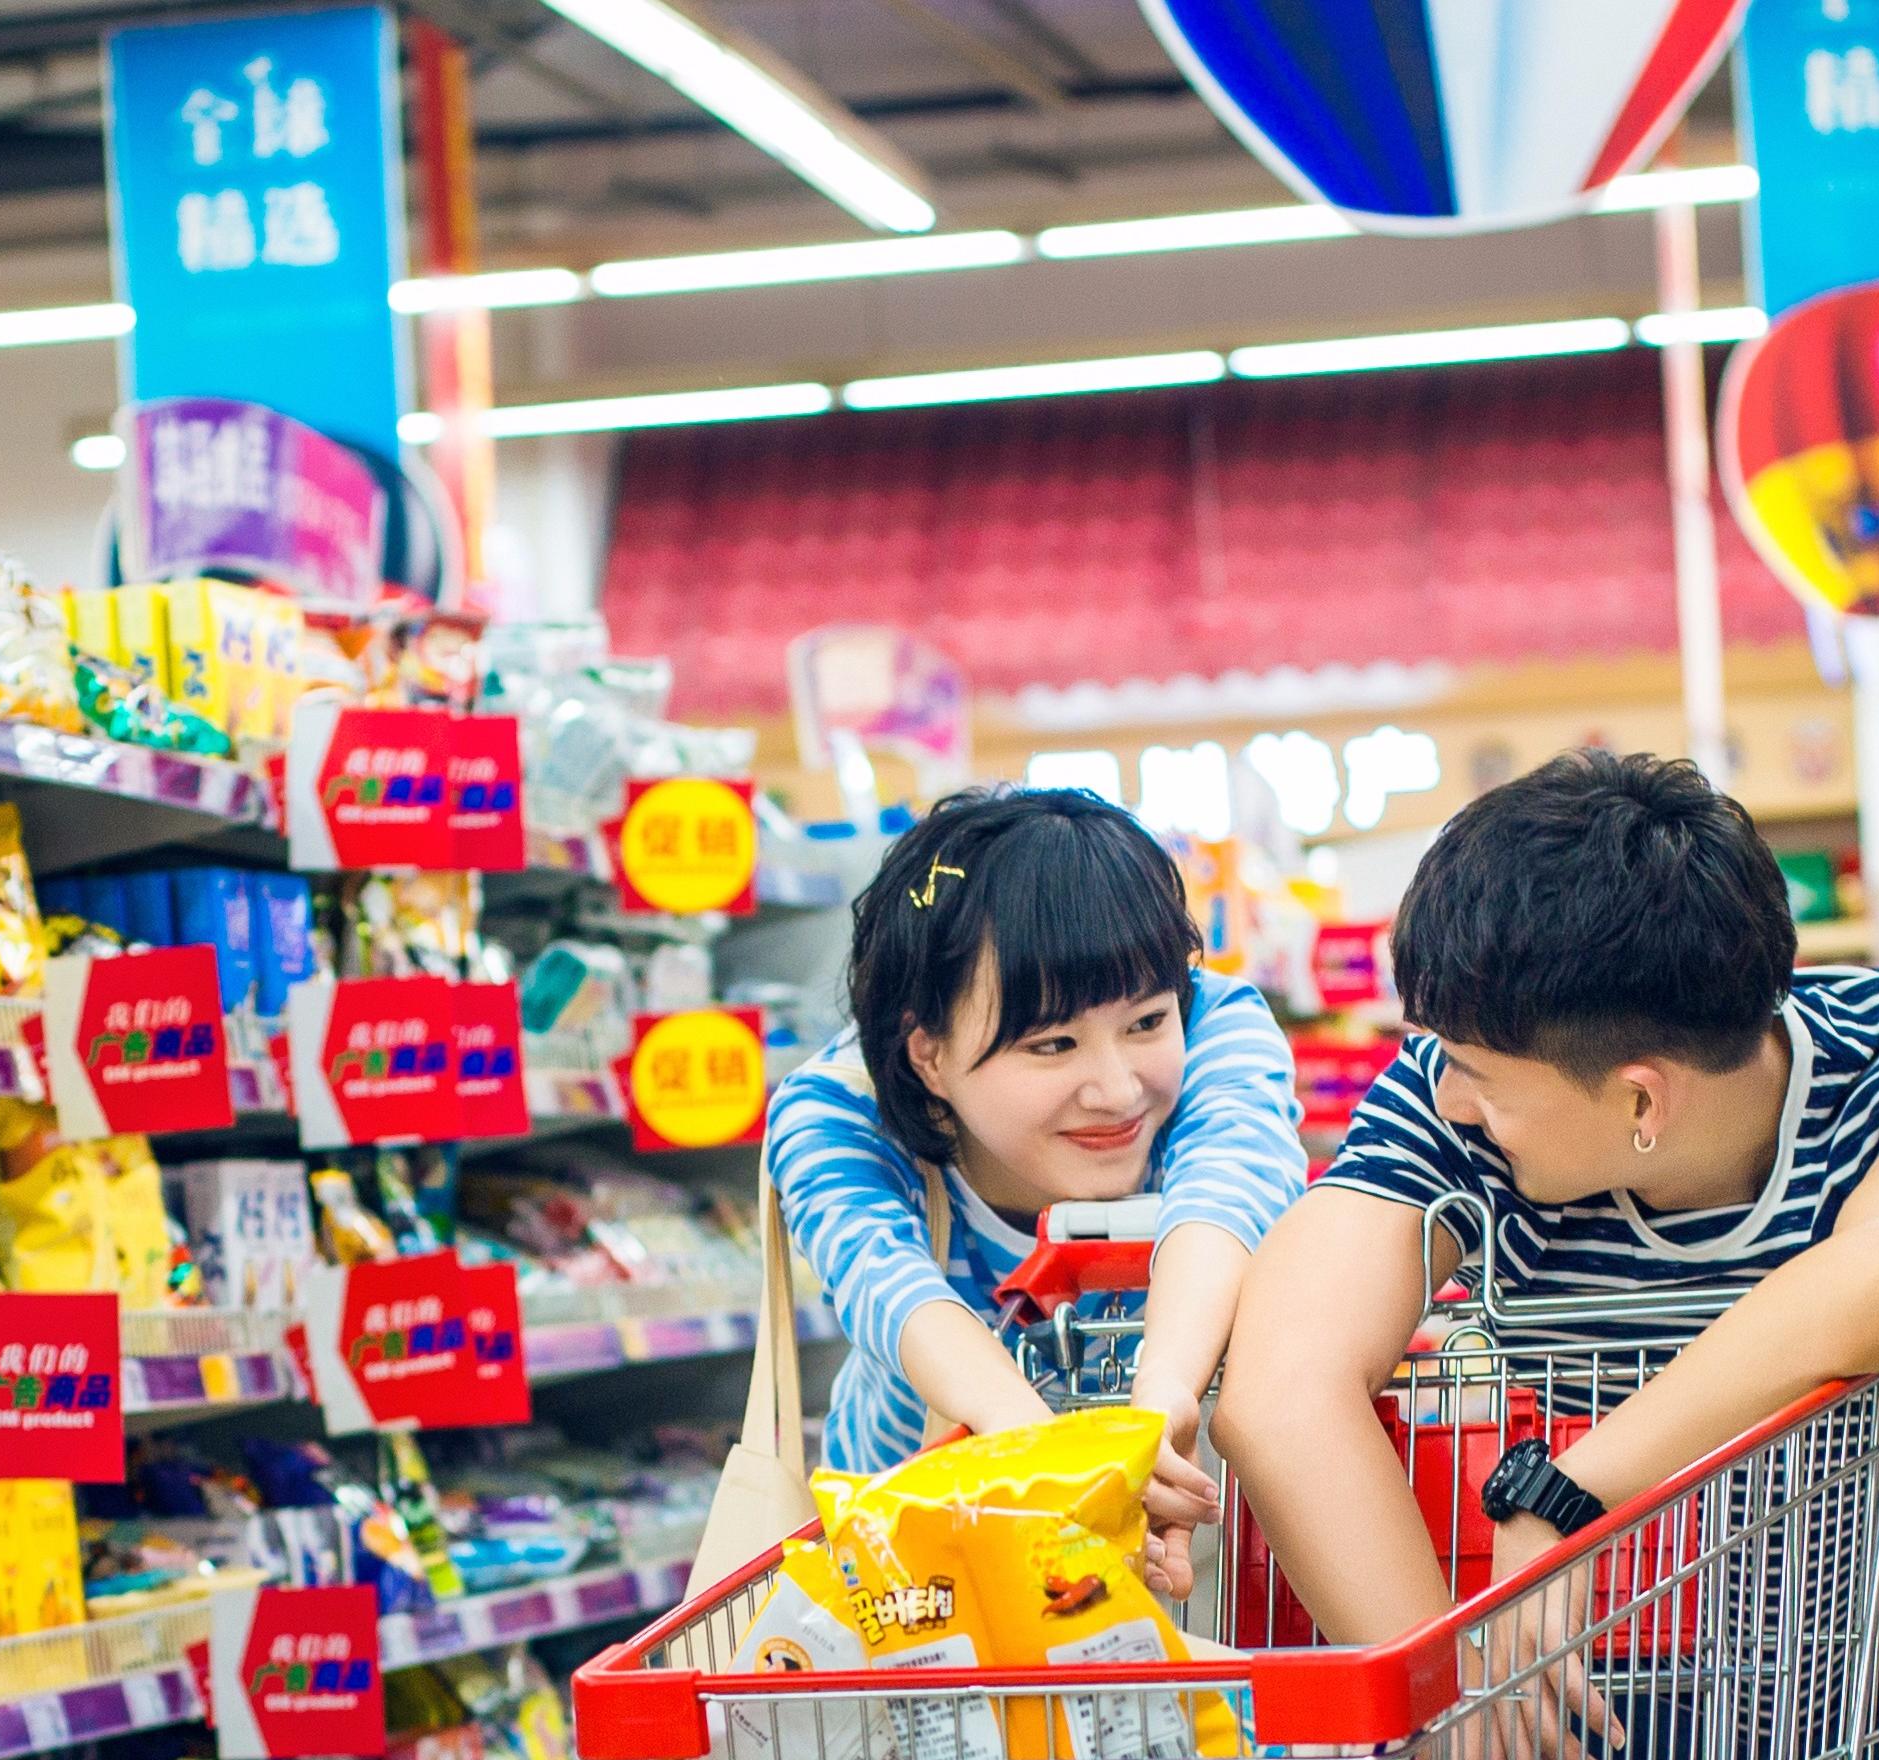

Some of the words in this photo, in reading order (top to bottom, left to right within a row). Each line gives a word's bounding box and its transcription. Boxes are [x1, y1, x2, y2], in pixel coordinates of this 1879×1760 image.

[86, 1021, 215, 1068] 广告商品
[349, 1318, 466, 1368] 广告商品
[24, 1409, 94, 1430] product
[250, 1660, 372, 1694] 广告商品
